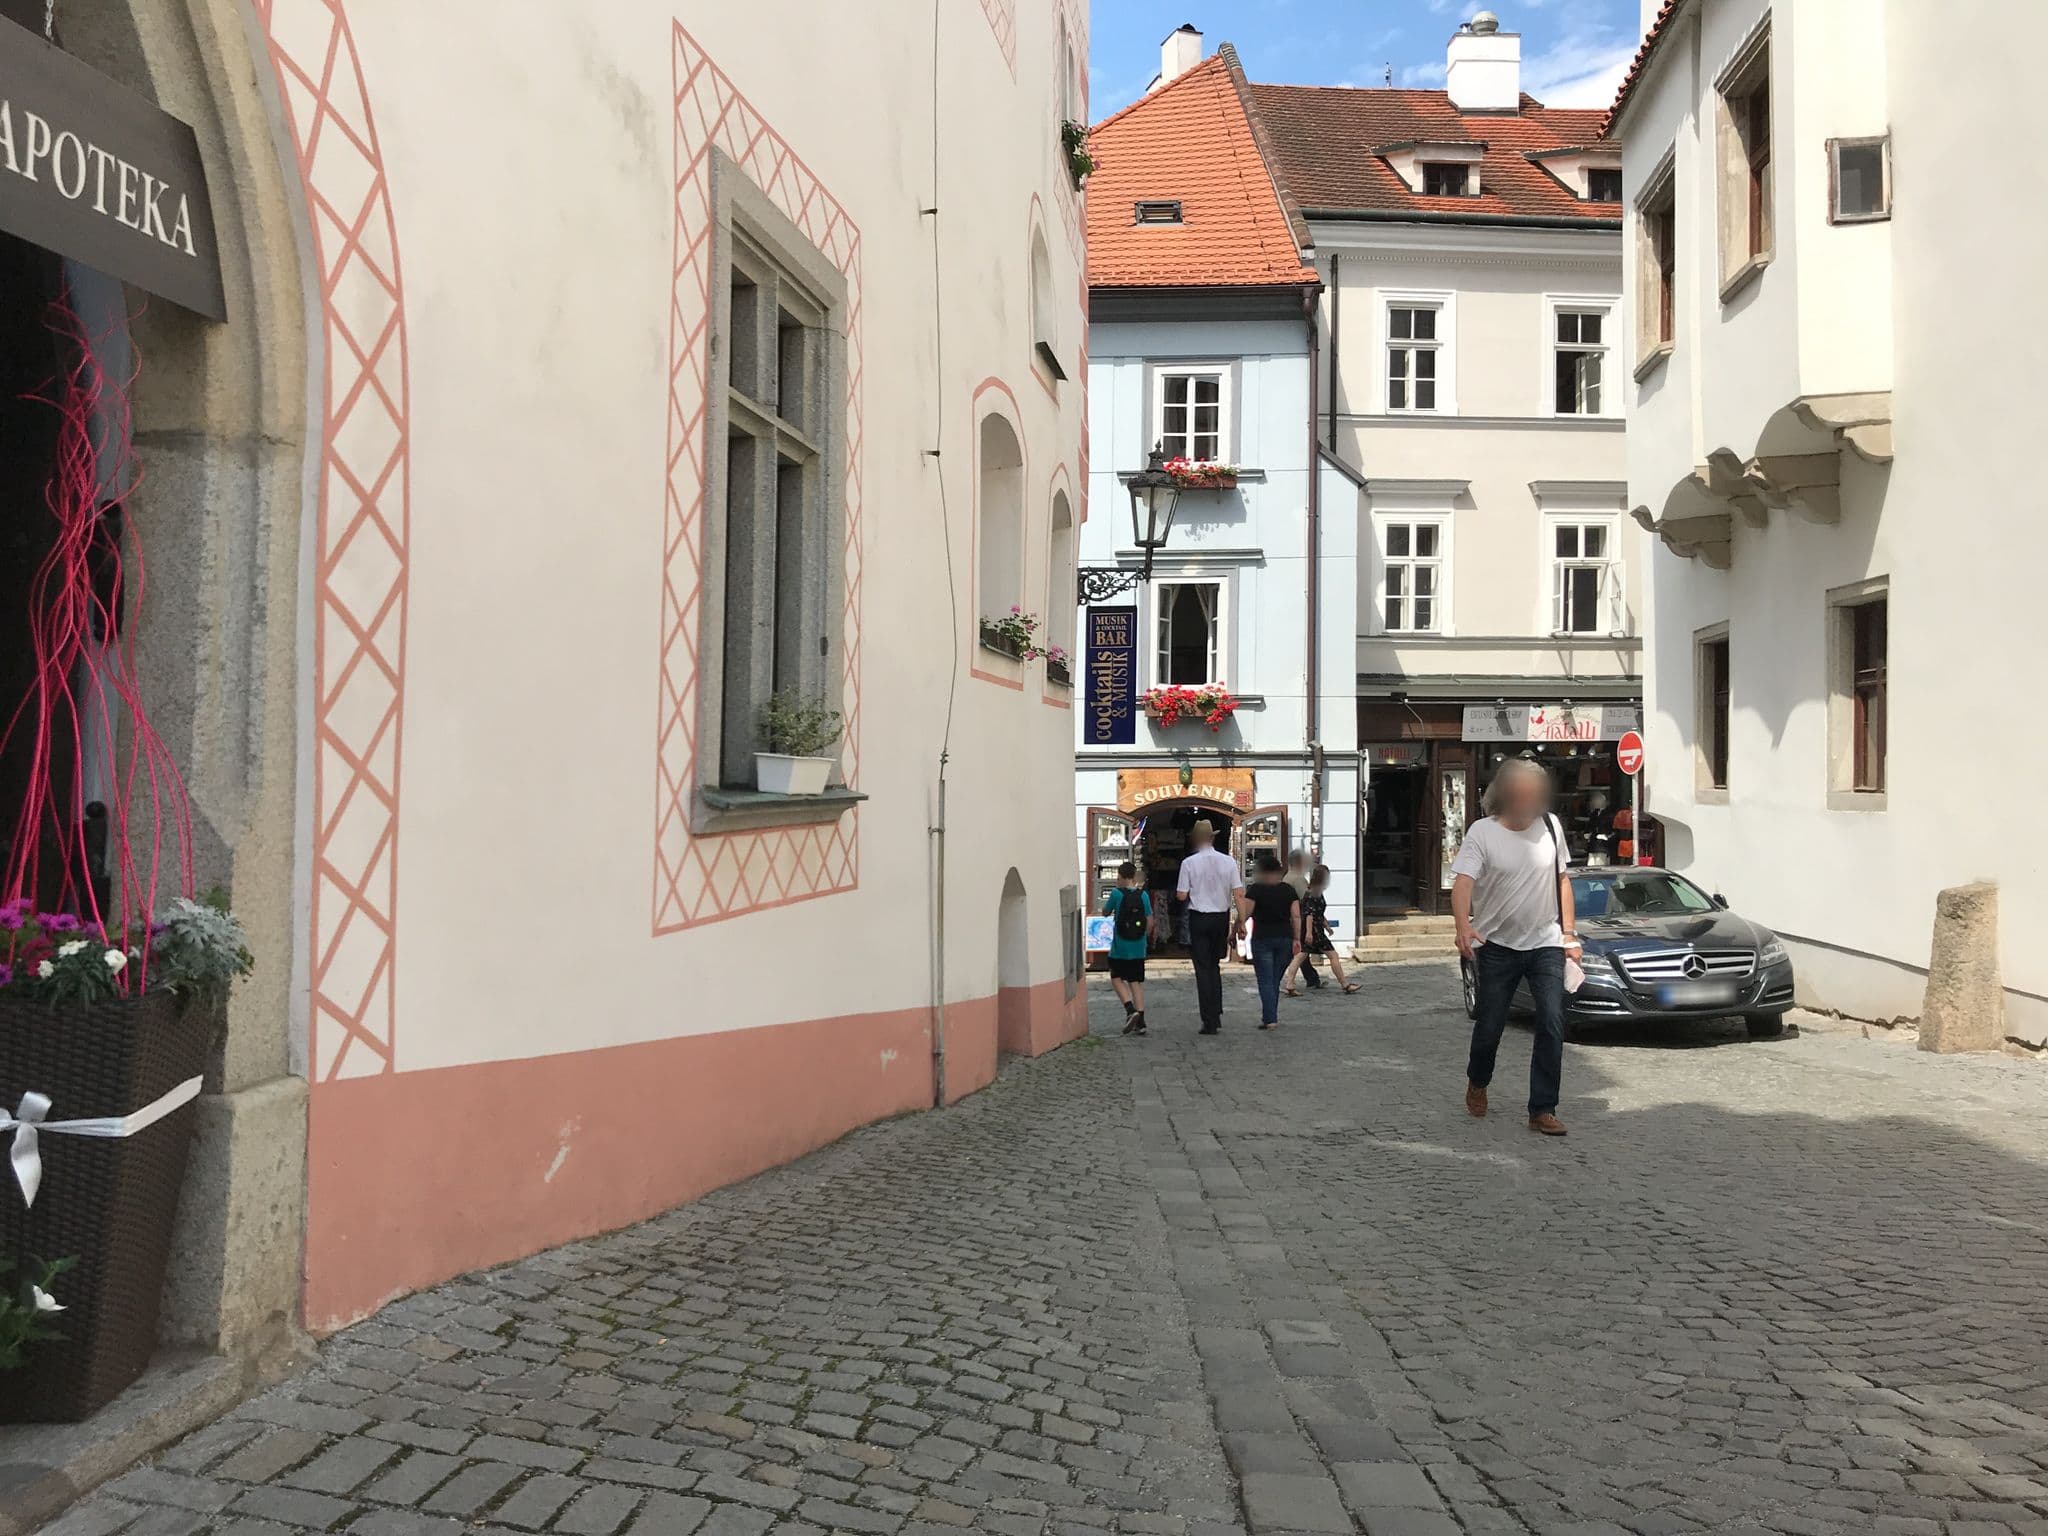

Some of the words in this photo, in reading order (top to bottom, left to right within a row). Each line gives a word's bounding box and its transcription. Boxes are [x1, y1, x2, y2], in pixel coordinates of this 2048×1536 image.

[0, 100, 197, 257] APOTEKA
[1096, 615, 1127, 625] MUSIK
[1096, 631, 1127, 646] BAR
[1112, 651, 1129, 702] MUSIK
[1090, 651, 1113, 741] cocktails
[1112, 706, 1127, 718] &
[1134, 783, 1236, 806] SOUVENIR
